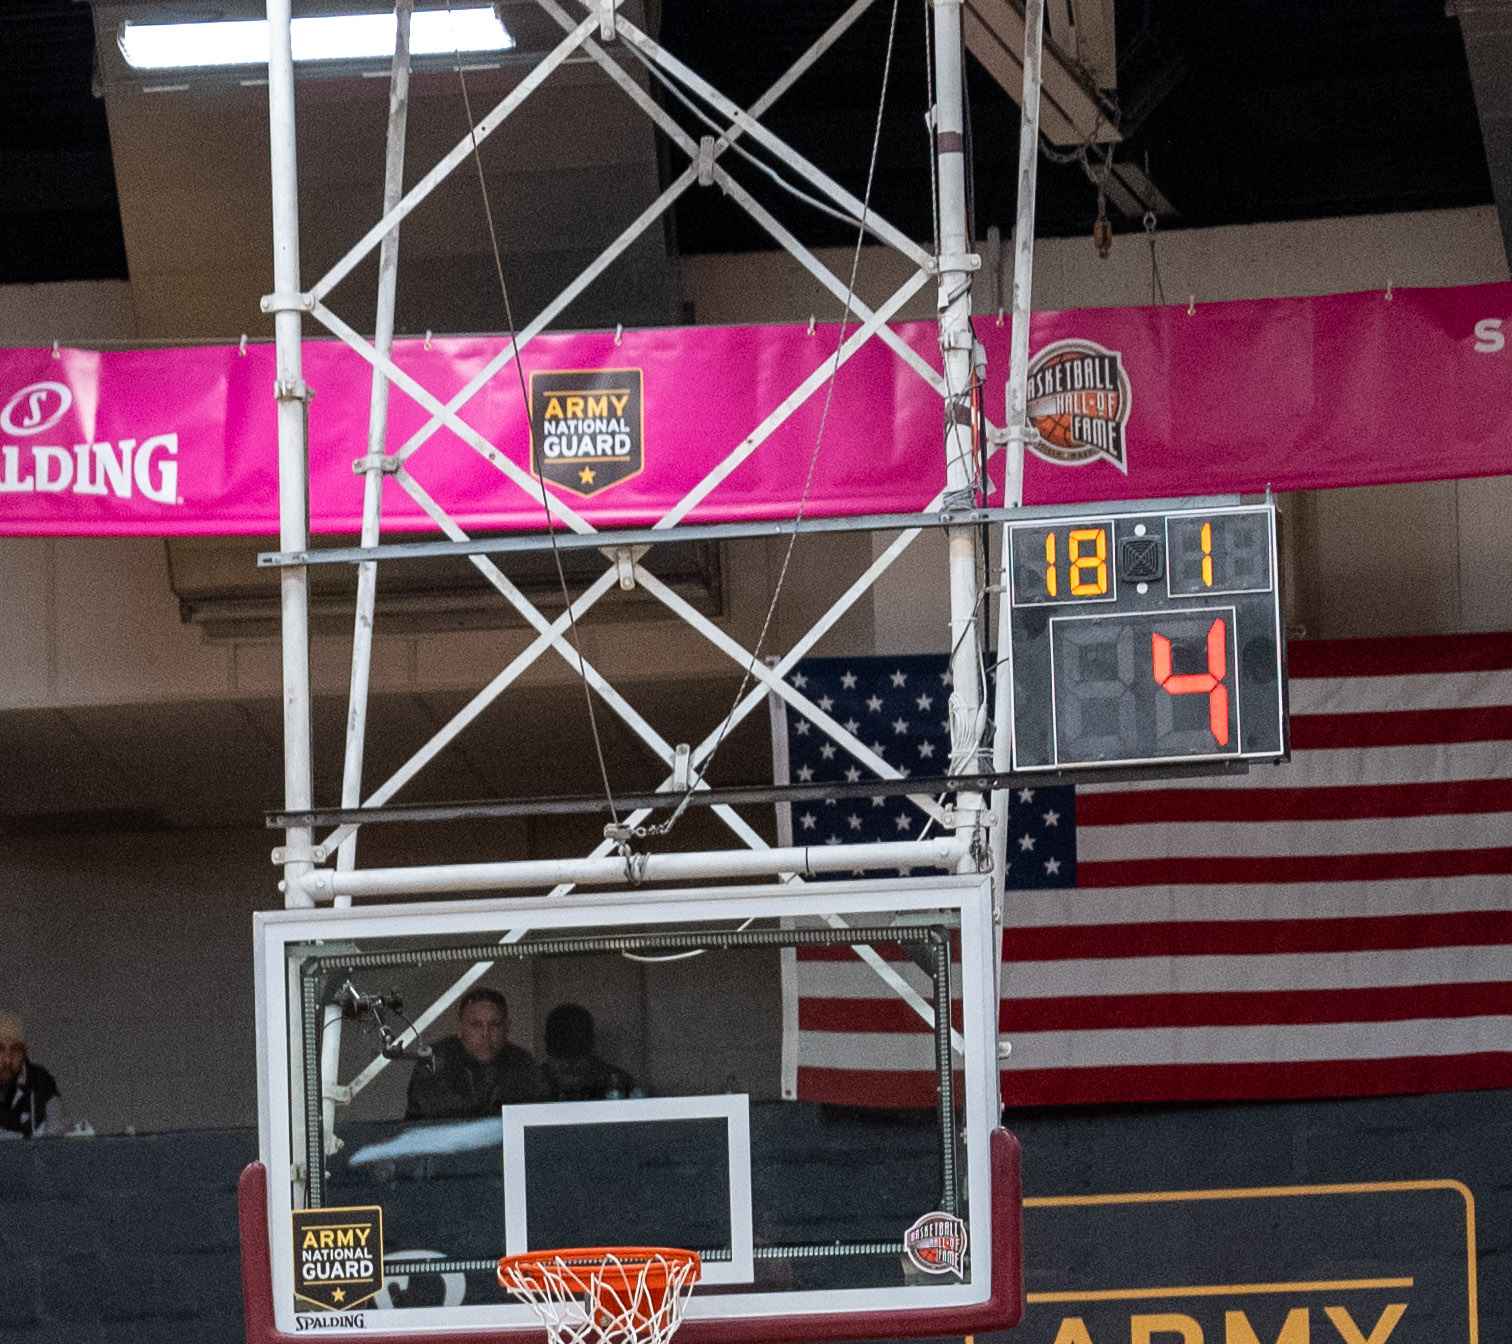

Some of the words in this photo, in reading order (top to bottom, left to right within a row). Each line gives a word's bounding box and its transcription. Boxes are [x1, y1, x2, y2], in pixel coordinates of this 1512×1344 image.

[1027, 357, 1114, 400] ASKETBALL
[544, 392, 629, 422] ARMY
[543, 416, 631, 436] NATIONAL
[1075, 417, 1118, 456] FAME
[543, 431, 632, 460] GUARD
[1045, 528, 1109, 598] 18
[1199, 522, 1215, 588] 1
[1150, 616, 1229, 747] 4
[302, 1228, 371, 1249] ARMY
[302, 1246, 373, 1262] NATIONAL
[302, 1260, 374, 1280] GUARD
[295, 1313, 365, 1332] SPALDING
